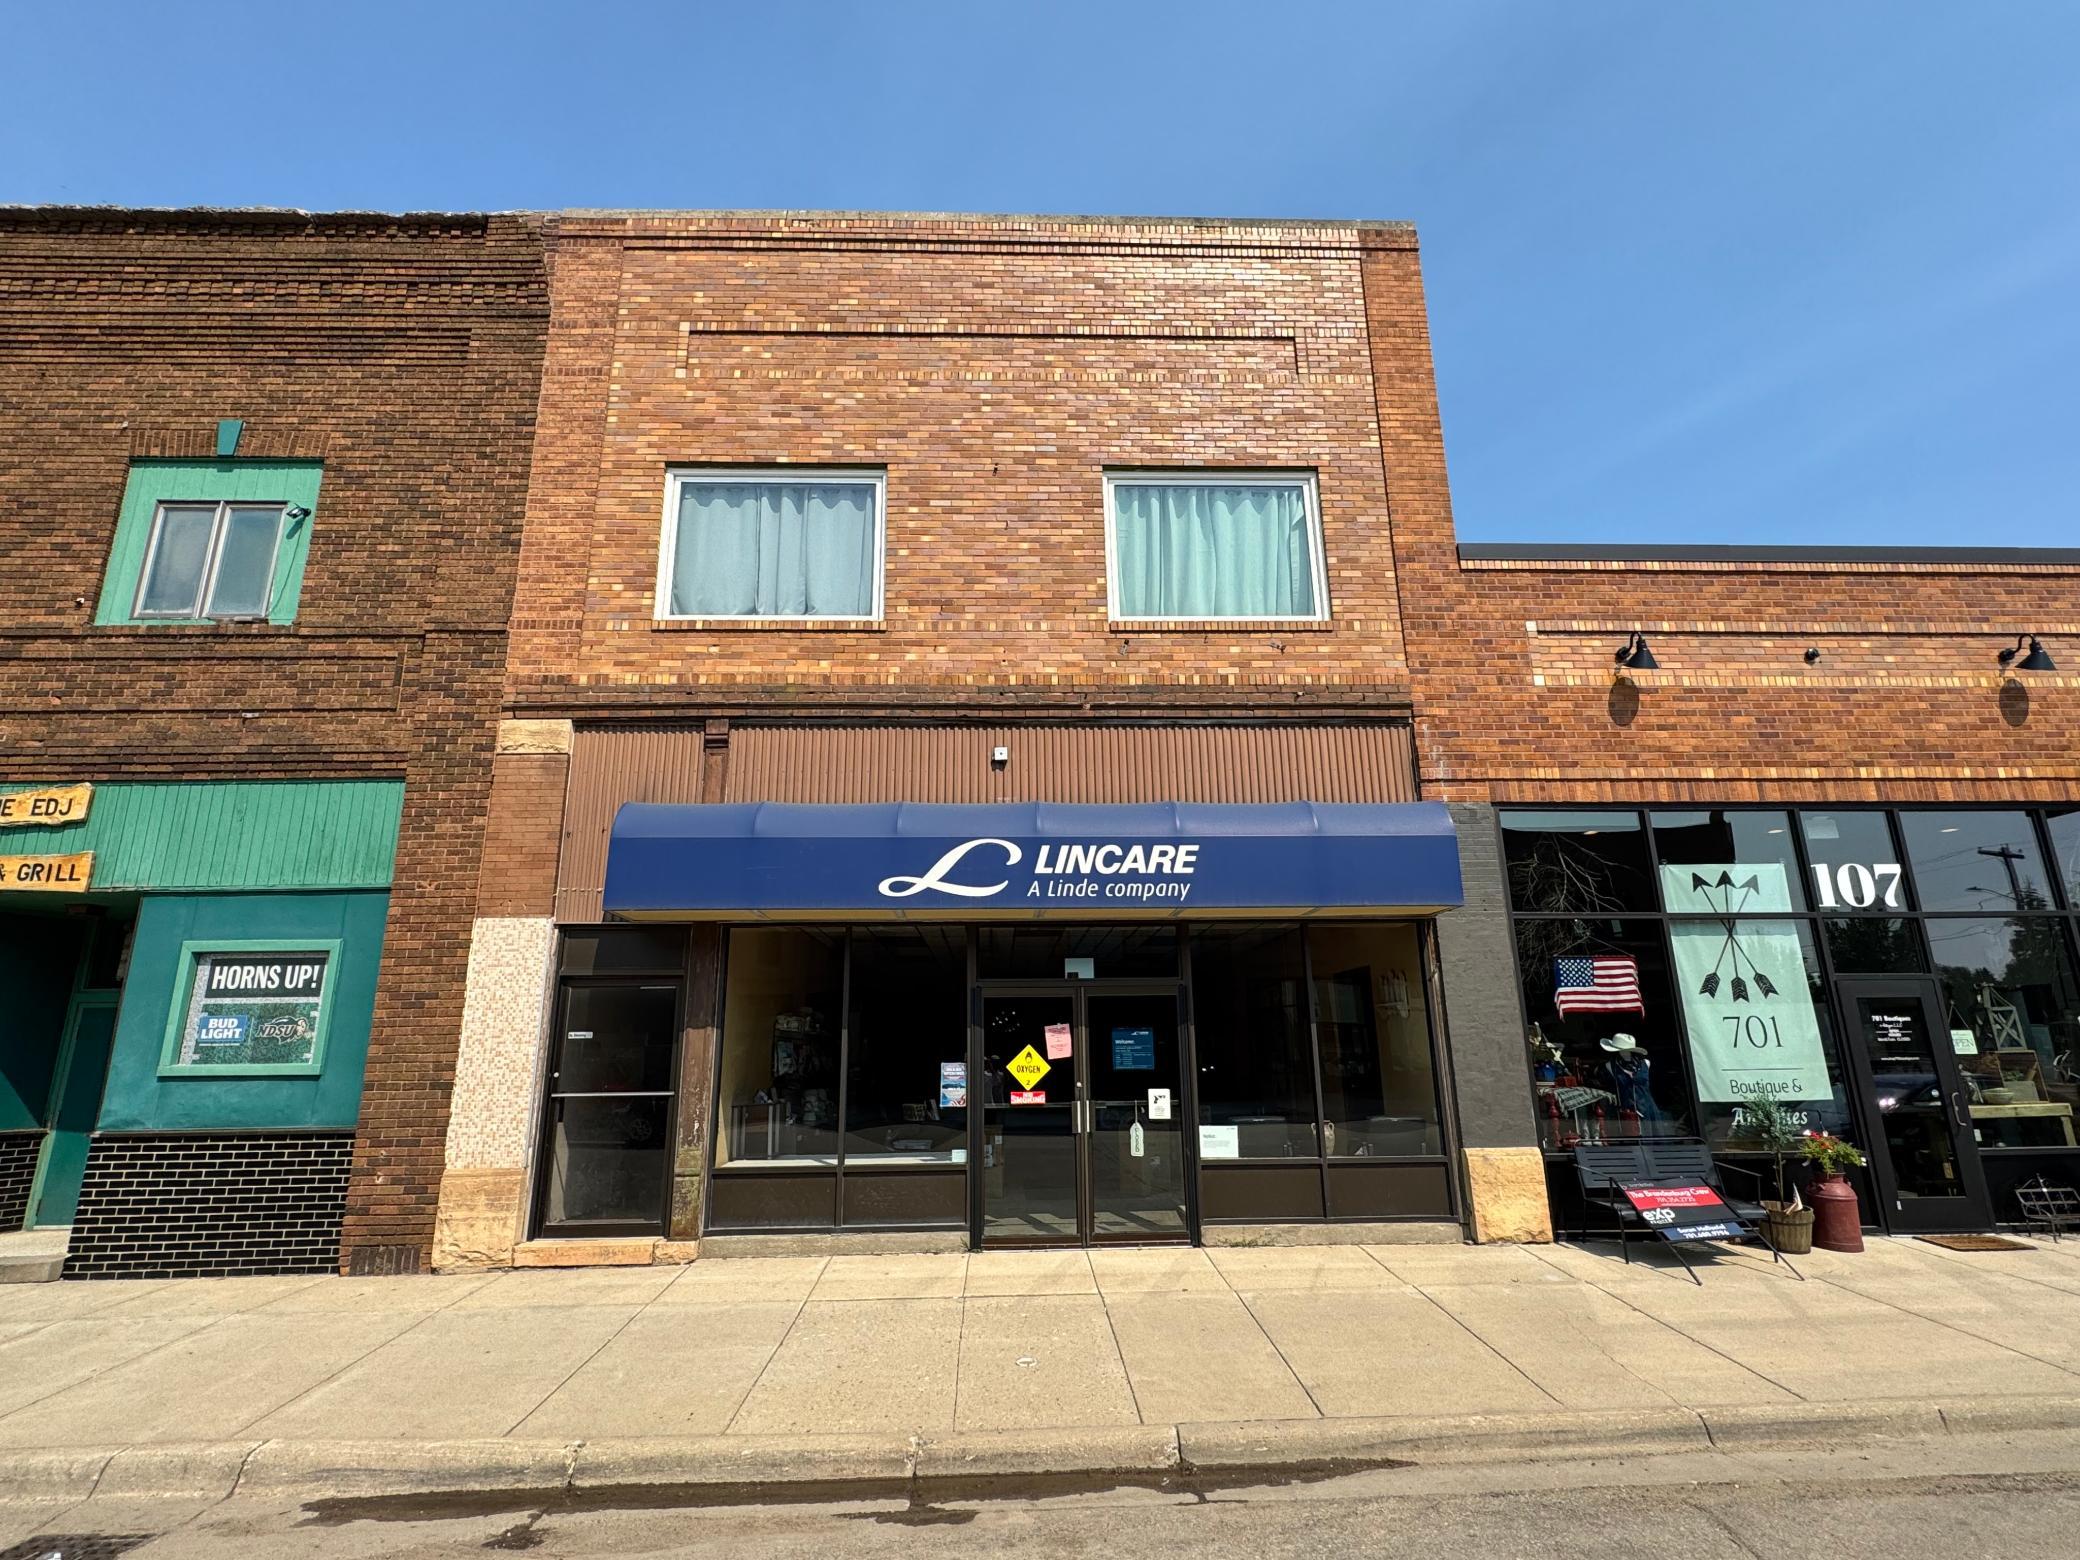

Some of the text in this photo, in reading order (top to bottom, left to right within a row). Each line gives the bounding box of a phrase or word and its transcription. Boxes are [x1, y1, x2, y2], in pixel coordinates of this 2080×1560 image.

[0, 798, 73, 817] E EDJ
[1034, 844, 1200, 874] LINCARE
[17, 863, 81, 882] GRILL
[1027, 878, 1191, 902] A Linde company
[1810, 863, 1902, 908] 107
[211, 964, 320, 990] HORNS UP!
[208, 1018, 239, 1029] BUD
[256, 1024, 298, 1038] NDSU
[1722, 1015, 1785, 1049] 701
[200, 1028, 242, 1039] LIGHT
[1016, 1064, 1041, 1074] OXYGEN
[1729, 1079, 1803, 1098] Boutique &
